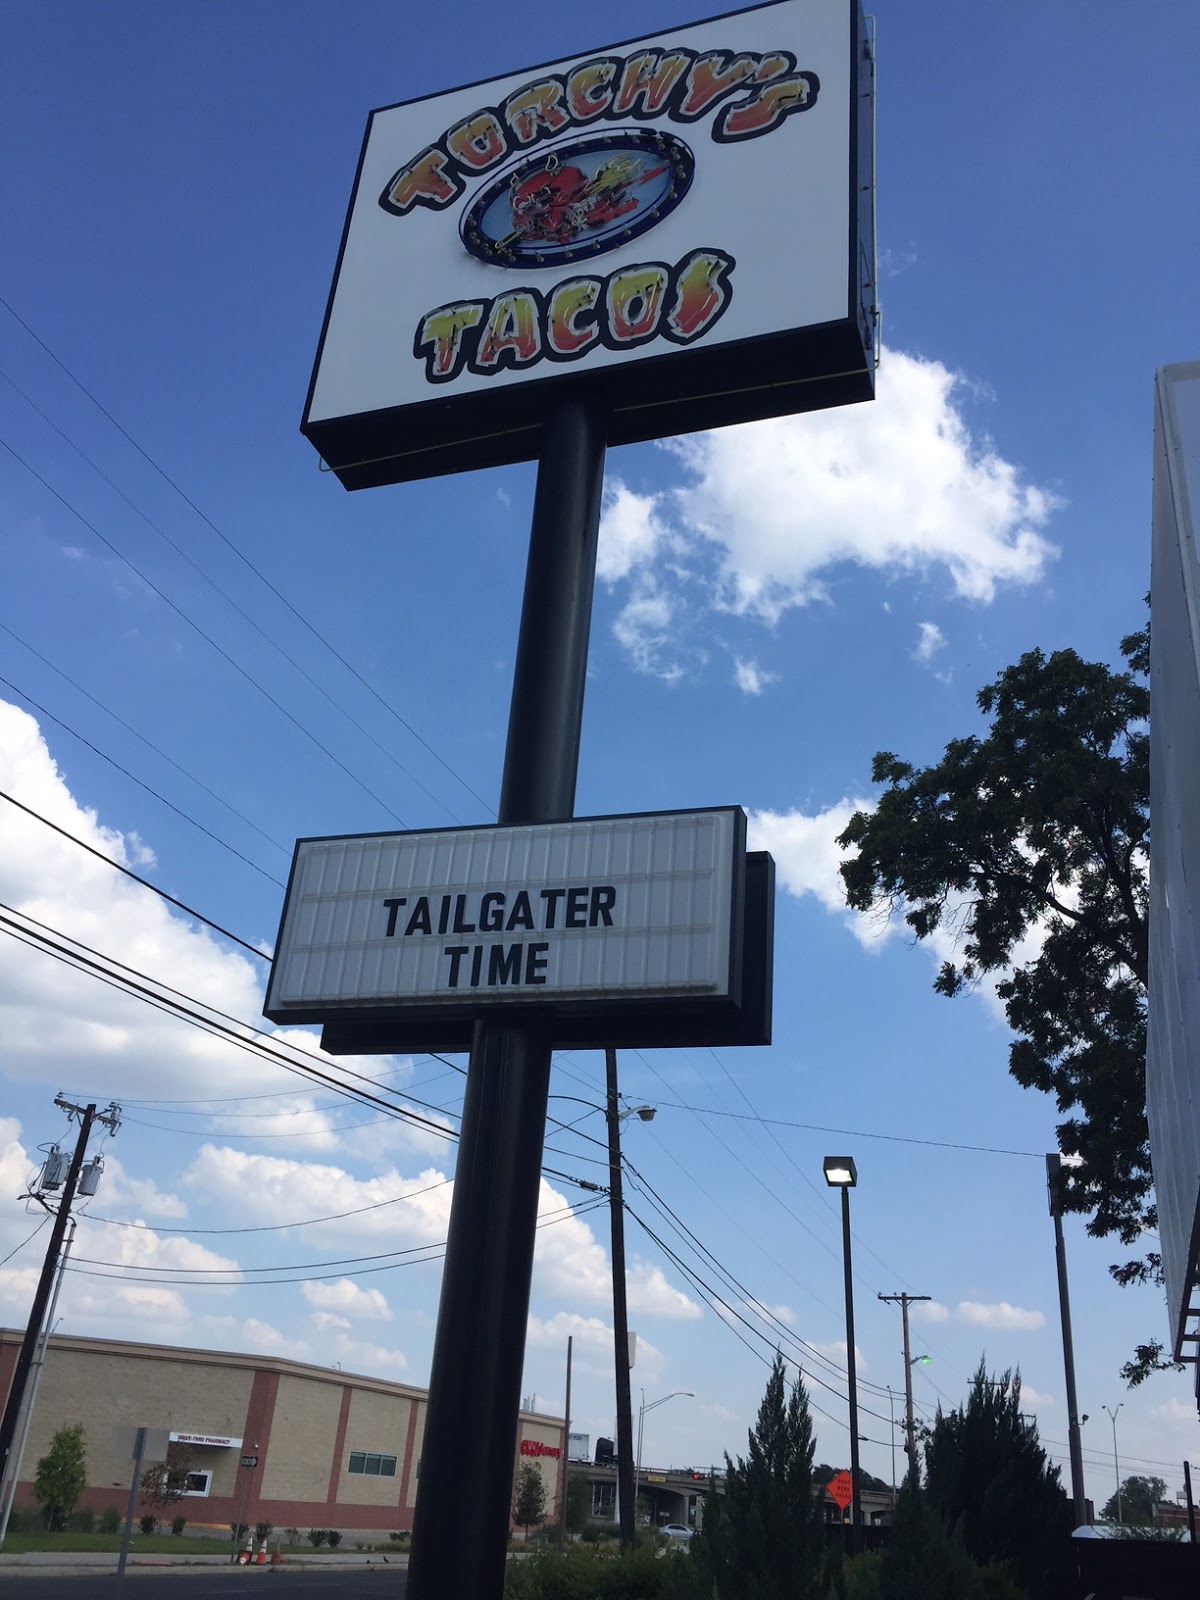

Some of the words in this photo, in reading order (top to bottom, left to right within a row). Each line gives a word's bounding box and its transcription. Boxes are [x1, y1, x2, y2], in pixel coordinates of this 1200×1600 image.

[379, 47, 820, 216] TORCHY'S
[413, 248, 736, 384] TACOS
[383, 885, 616, 937] TAILGATER
[444, 942, 549, 988] TIME
[177, 1434, 205, 1442] DRIVE-THRU
[205, 1437, 231, 1445] PHARMACY
[835, 1492, 852, 1500] AHEAD
